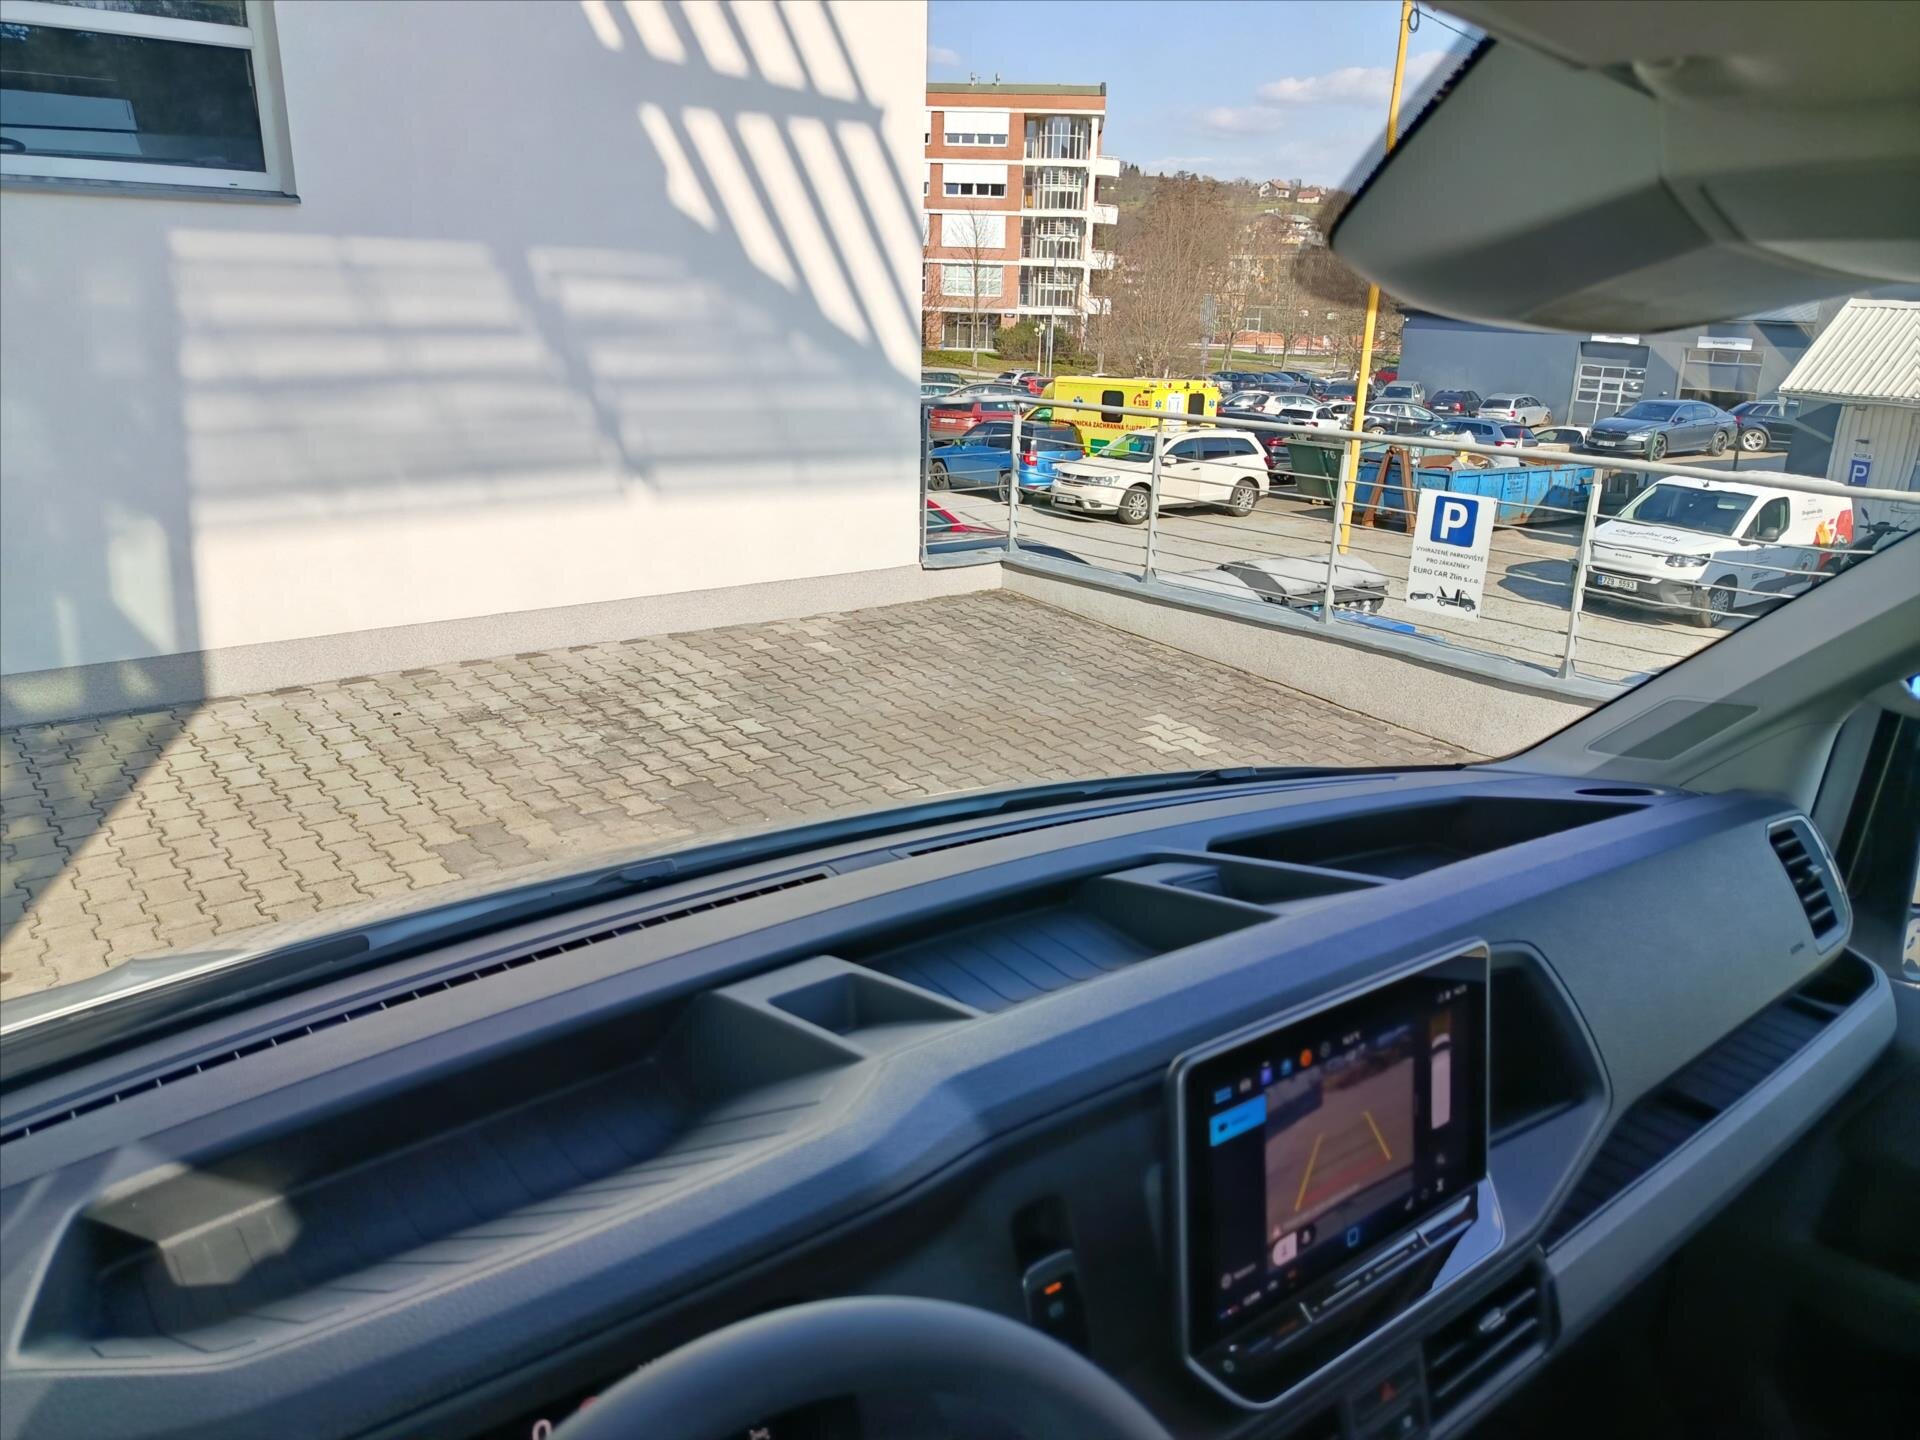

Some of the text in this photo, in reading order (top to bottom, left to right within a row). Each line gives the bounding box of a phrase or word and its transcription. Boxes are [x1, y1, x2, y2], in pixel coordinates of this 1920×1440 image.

[1851, 464, 1868, 483] P
[1440, 501, 1469, 540] P
[1426, 557, 1439, 565] PRO
[1413, 565, 1433, 575] EURO
[1434, 569, 1448, 578] CAR
